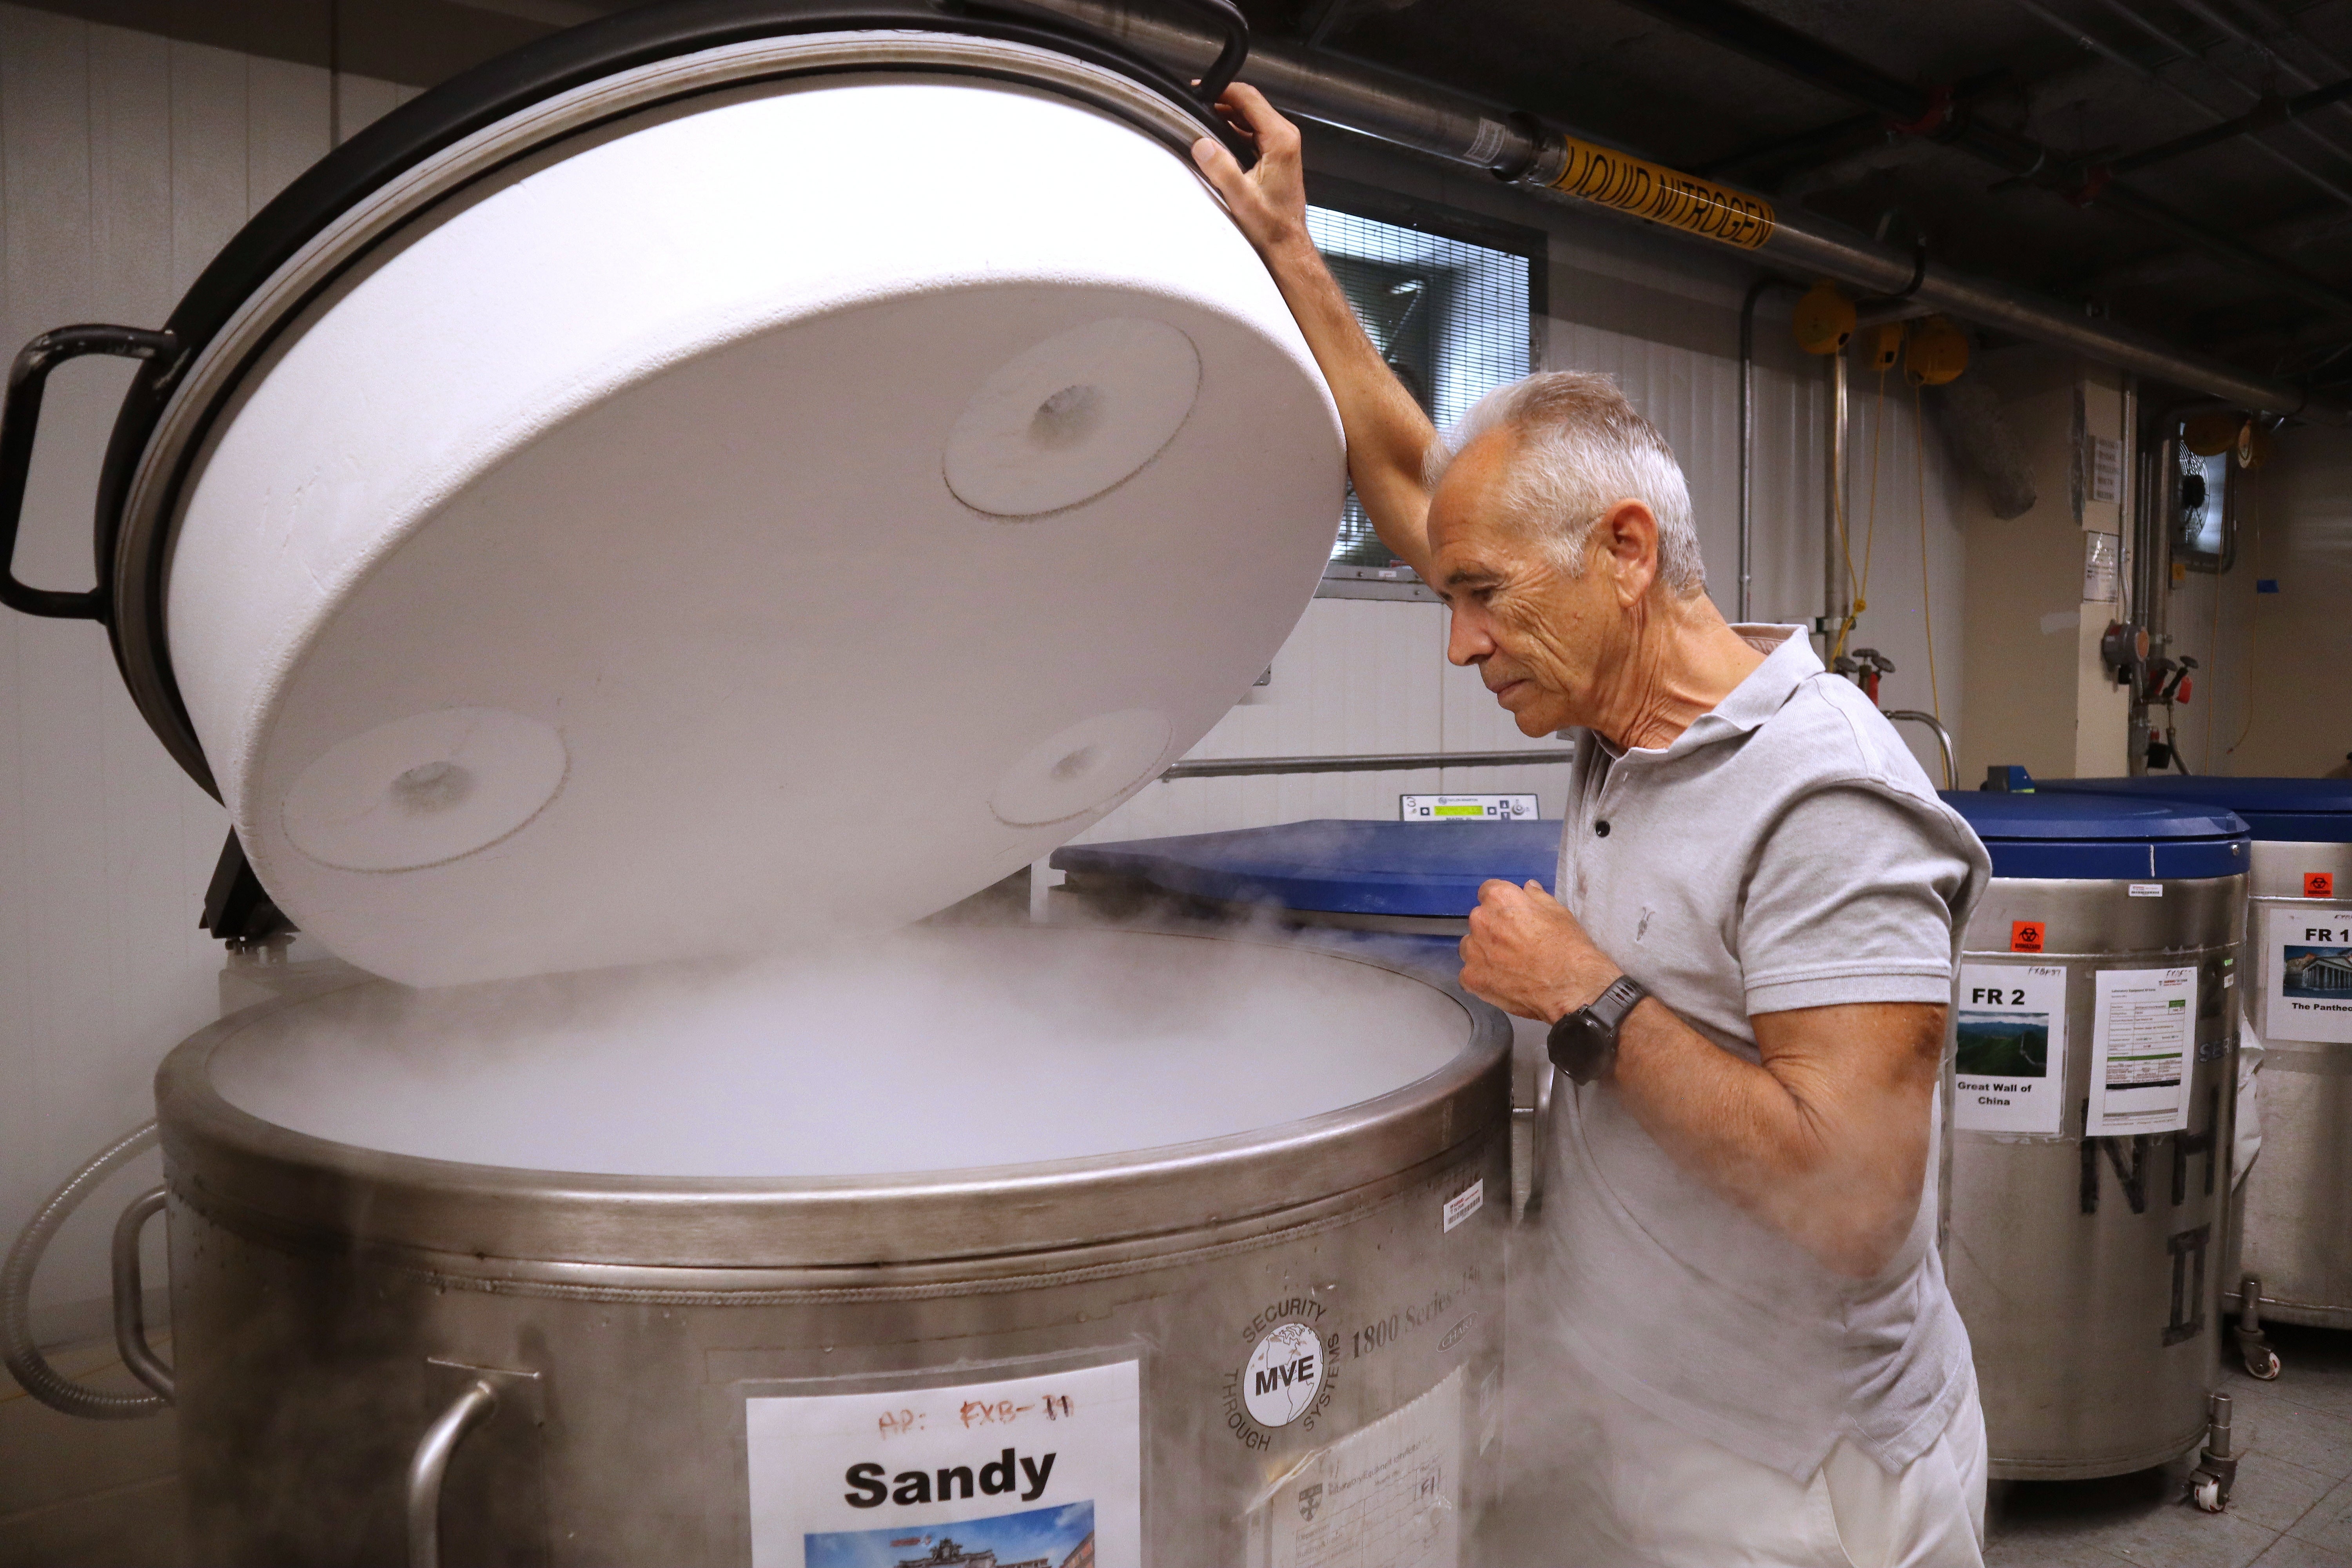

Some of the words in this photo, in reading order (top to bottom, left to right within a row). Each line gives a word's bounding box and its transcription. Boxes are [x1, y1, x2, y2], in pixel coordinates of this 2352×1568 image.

[1551, 146, 1651, 209] LIQUID
[1644, 174, 1772, 248] NITROGEN
[2305, 929, 2332, 942] FR
[2340, 929, 2348, 942] 1
[1972, 988, 2003, 1005] FR
[2012, 989, 2025, 1005] 2
[1958, 1082, 1990, 1091] Great
[1993, 1083, 2017, 1093] Wall
[2021, 1083, 2032, 1093] of
[1978, 1097, 2011, 1106] China
[1243, 1297, 1328, 1343] SECURITY
[1352, 1314, 1399, 1359] 1800
[1405, 1290, 1452, 1333] Series
[1255, 1355, 1314, 1396] MVE
[1304, 1333, 1341, 1431] SYSTEMS
[1223, 1369, 1271, 1452] THROUGH
[844, 1448, 1056, 1509] Sandy
